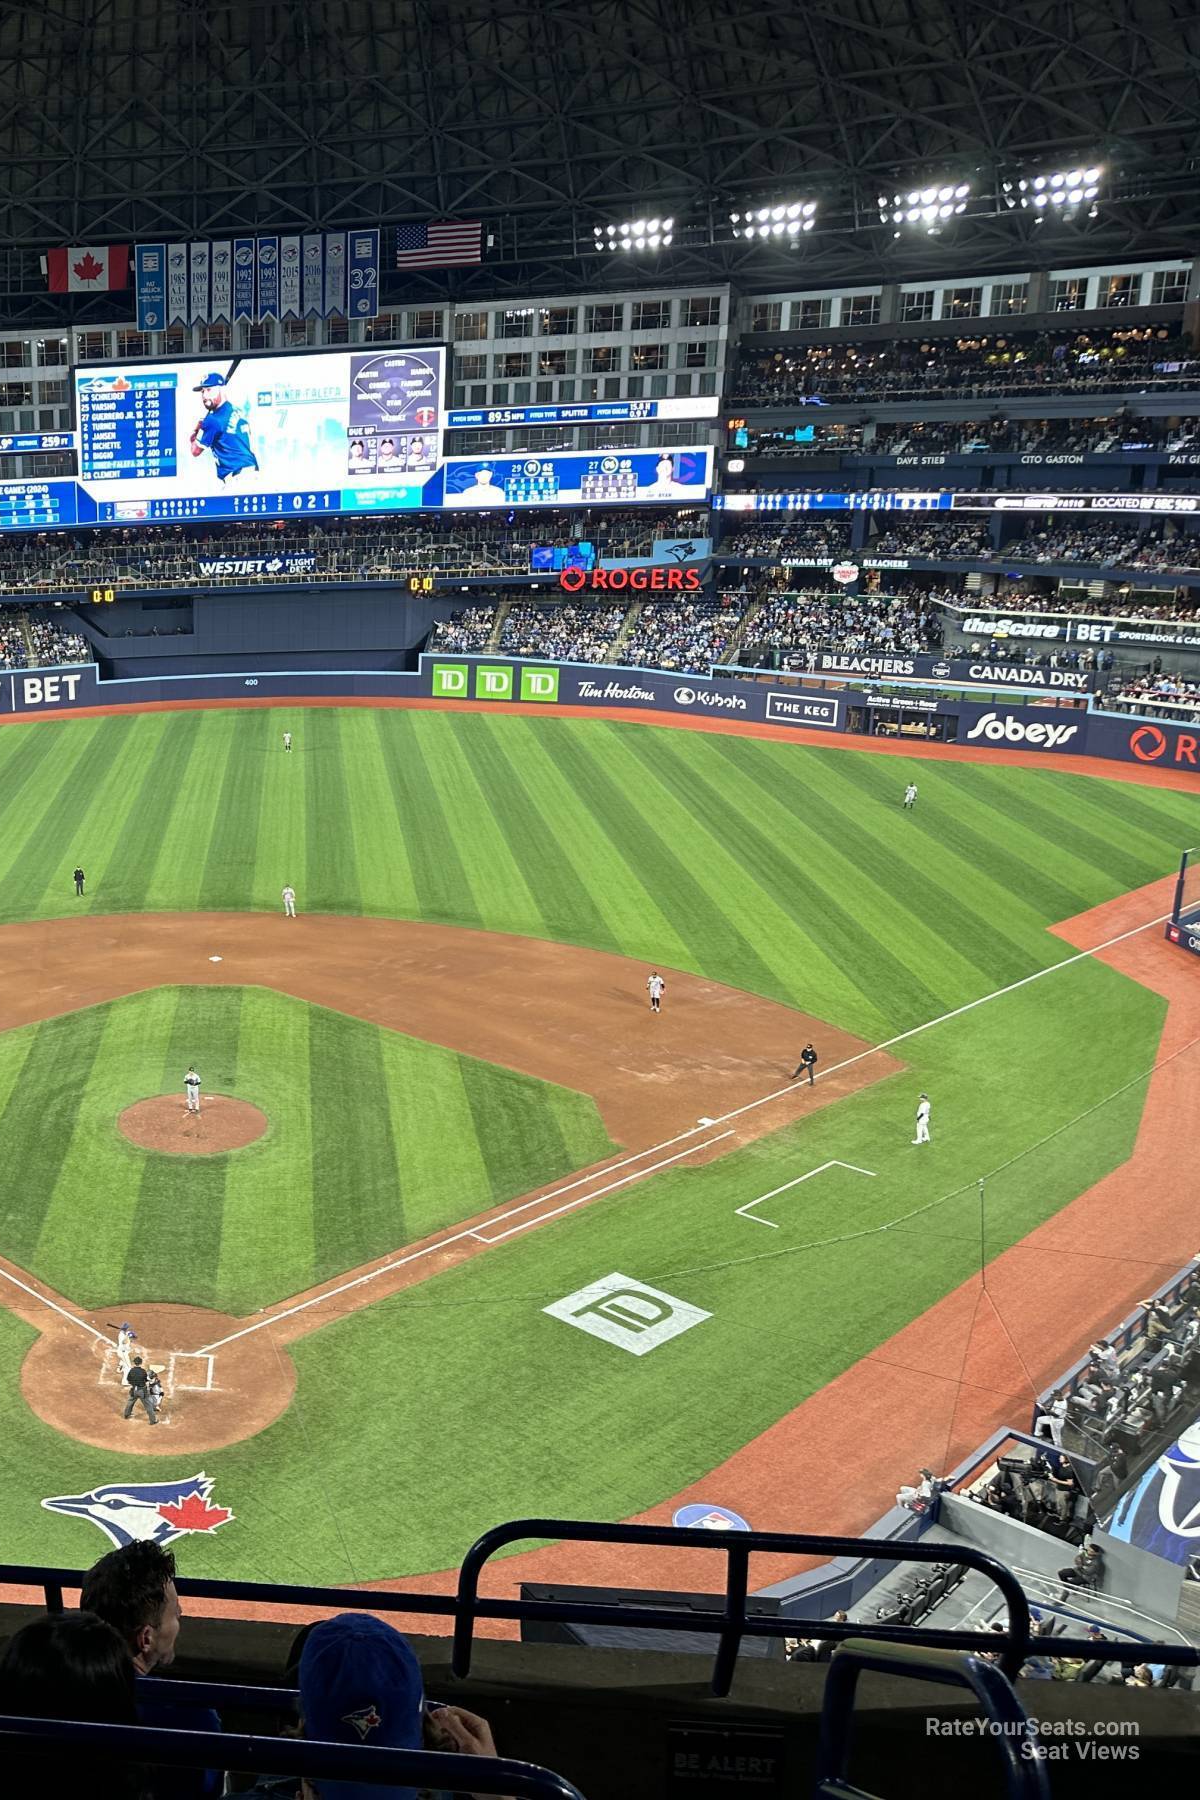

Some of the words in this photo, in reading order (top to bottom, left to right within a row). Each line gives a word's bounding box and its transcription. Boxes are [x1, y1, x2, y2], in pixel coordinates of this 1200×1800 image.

[192, 272, 207, 284] 1989
[214, 271, 229, 283] 1991
[236, 269, 252, 281] 1992
[260, 267, 276, 280] 1993
[282, 266, 298, 278] 2015
[350, 267, 378, 290] 32
[170, 273, 186, 285] 1985
[170, 296, 186, 305] EAST
[192, 296, 207, 304] EAST
[214, 294, 229, 302] EAST
[488, 411, 512, 422] 89.5
[512, 412, 524, 420] MPH
[562, 409, 588, 417] SPLITTER
[348, 428, 363, 436] DUE
[42, 436, 60, 447] 259
[588, 462, 598, 470] 27
[896, 456, 918, 466] DAVE
[921, 456, 946, 465] STIEB
[1021, 455, 1042, 464] CITO
[1045, 454, 1084, 465] GASTON
[1168, 455, 1187, 464] PAT
[512, 464, 522, 472] 29
[4, 486, 26, 494] GAMES
[292, 495, 302, 509] 0
[308, 494, 316, 508] 2
[324, 494, 330, 508] 1
[1091, 498, 1140, 508] LOCATED
[200, 560, 266, 576] WESTJET
[285, 558, 316, 568] FLIGHT
[862, 560, 908, 568] BLEACHERS
[410, 578, 433, 591] 0:10
[592, 568, 700, 590] ROGERS
[93, 590, 114, 603] 0:10
[962, 616, 1060, 639] theScore
[1076, 624, 1116, 643] BET
[1118, 632, 1176, 643] SPORTSBOOK
[1176, 636, 1183, 644] &
[1184, 636, 1200, 645] CAS
[822, 654, 914, 676] BLEACHERS
[968, 665, 1044, 685] CANADA
[244, 678, 258, 686] 400
[437, 670, 465, 690] TD
[480, 671, 510, 692] TD
[526, 673, 555, 694] TD
[24, 674, 82, 705] BET
[578, 681, 603, 698] Tim
[604, 682, 655, 700] Hortons
[697, 691, 747, 710] Kubota
[866, 695, 890, 704] Active
[774, 702, 800, 714] THE
[804, 705, 830, 717] KEG
[966, 712, 1078, 748] Sobeys
[1175, 735, 1200, 765] R
[570, 1288, 675, 1334] TD
[674, 1752, 700, 1768] BE
[707, 1754, 776, 1776] ALERT
